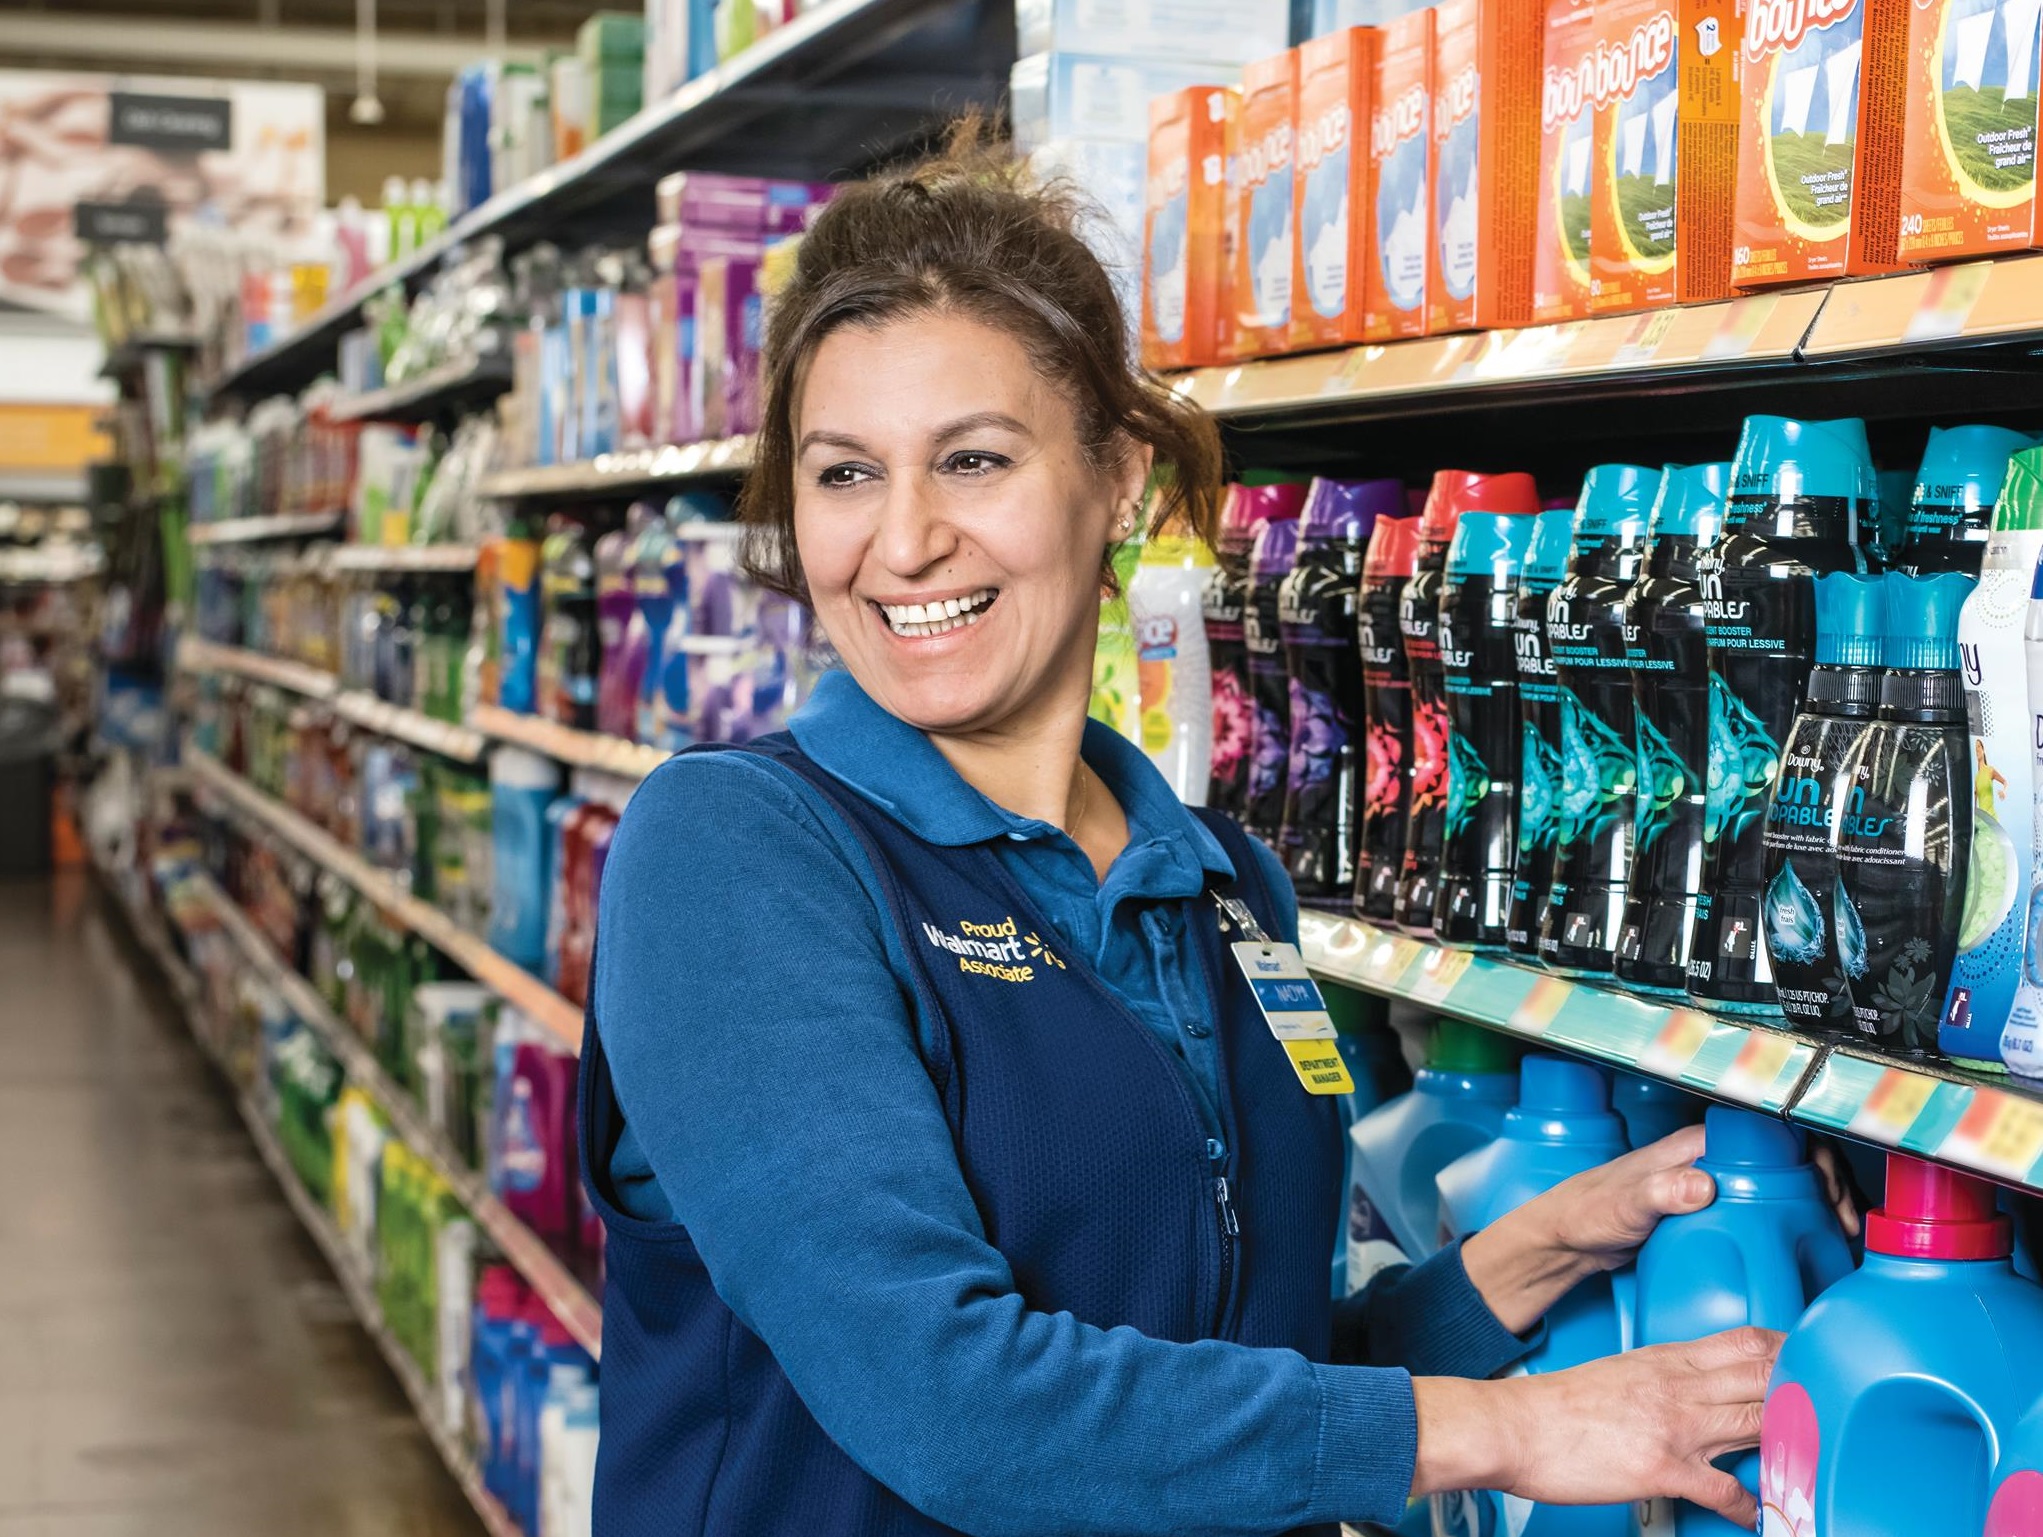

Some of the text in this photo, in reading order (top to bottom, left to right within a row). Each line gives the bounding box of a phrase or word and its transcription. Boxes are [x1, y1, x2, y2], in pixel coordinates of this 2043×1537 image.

[1750, 0, 1858, 52] bou
[1593, 14, 1672, 104] bounce
[1542, 55, 1594, 126] boun
[1977, 131, 2007, 144] Outdoor
[2022, 140, 2033, 152] de
[1995, 154, 2017, 169] grand
[1800, 174, 1827, 186] Outdoor
[1838, 181, 1849, 192] de
[1815, 196, 1835, 208] grand
[1901, 213, 1923, 237] 240
[1743, 473, 1769, 489] SNIFF
[1925, 484, 1963, 499] & SNIFF
[1718, 627, 1752, 637] BOOSTER
[1726, 638, 1785, 649] POUR LESSIVE
[1566, 647, 1598, 656] BOOSTER
[1574, 658, 1595, 667] POUR
[1645, 660, 1676, 670] LESSIVE
[1768, 803, 1834, 829] OPABLE
[1791, 834, 1805, 843] with
[1805, 835, 1827, 844] fabric
[1786, 842, 1794, 850] de
[1808, 845, 1824, 853] avec
[1864, 856, 1906, 866] adoucissant
[1780, 905, 1795, 915] fresh
[1780, 915, 1795, 925] frais
[959, 916, 1018, 938] Proud
[922, 922, 1026, 962] Walmart
[959, 957, 1035, 983] Associate
[1299, 1058, 1338, 1071] DEPARTMENT
[1311, 1072, 1342, 1085] MANAGER
